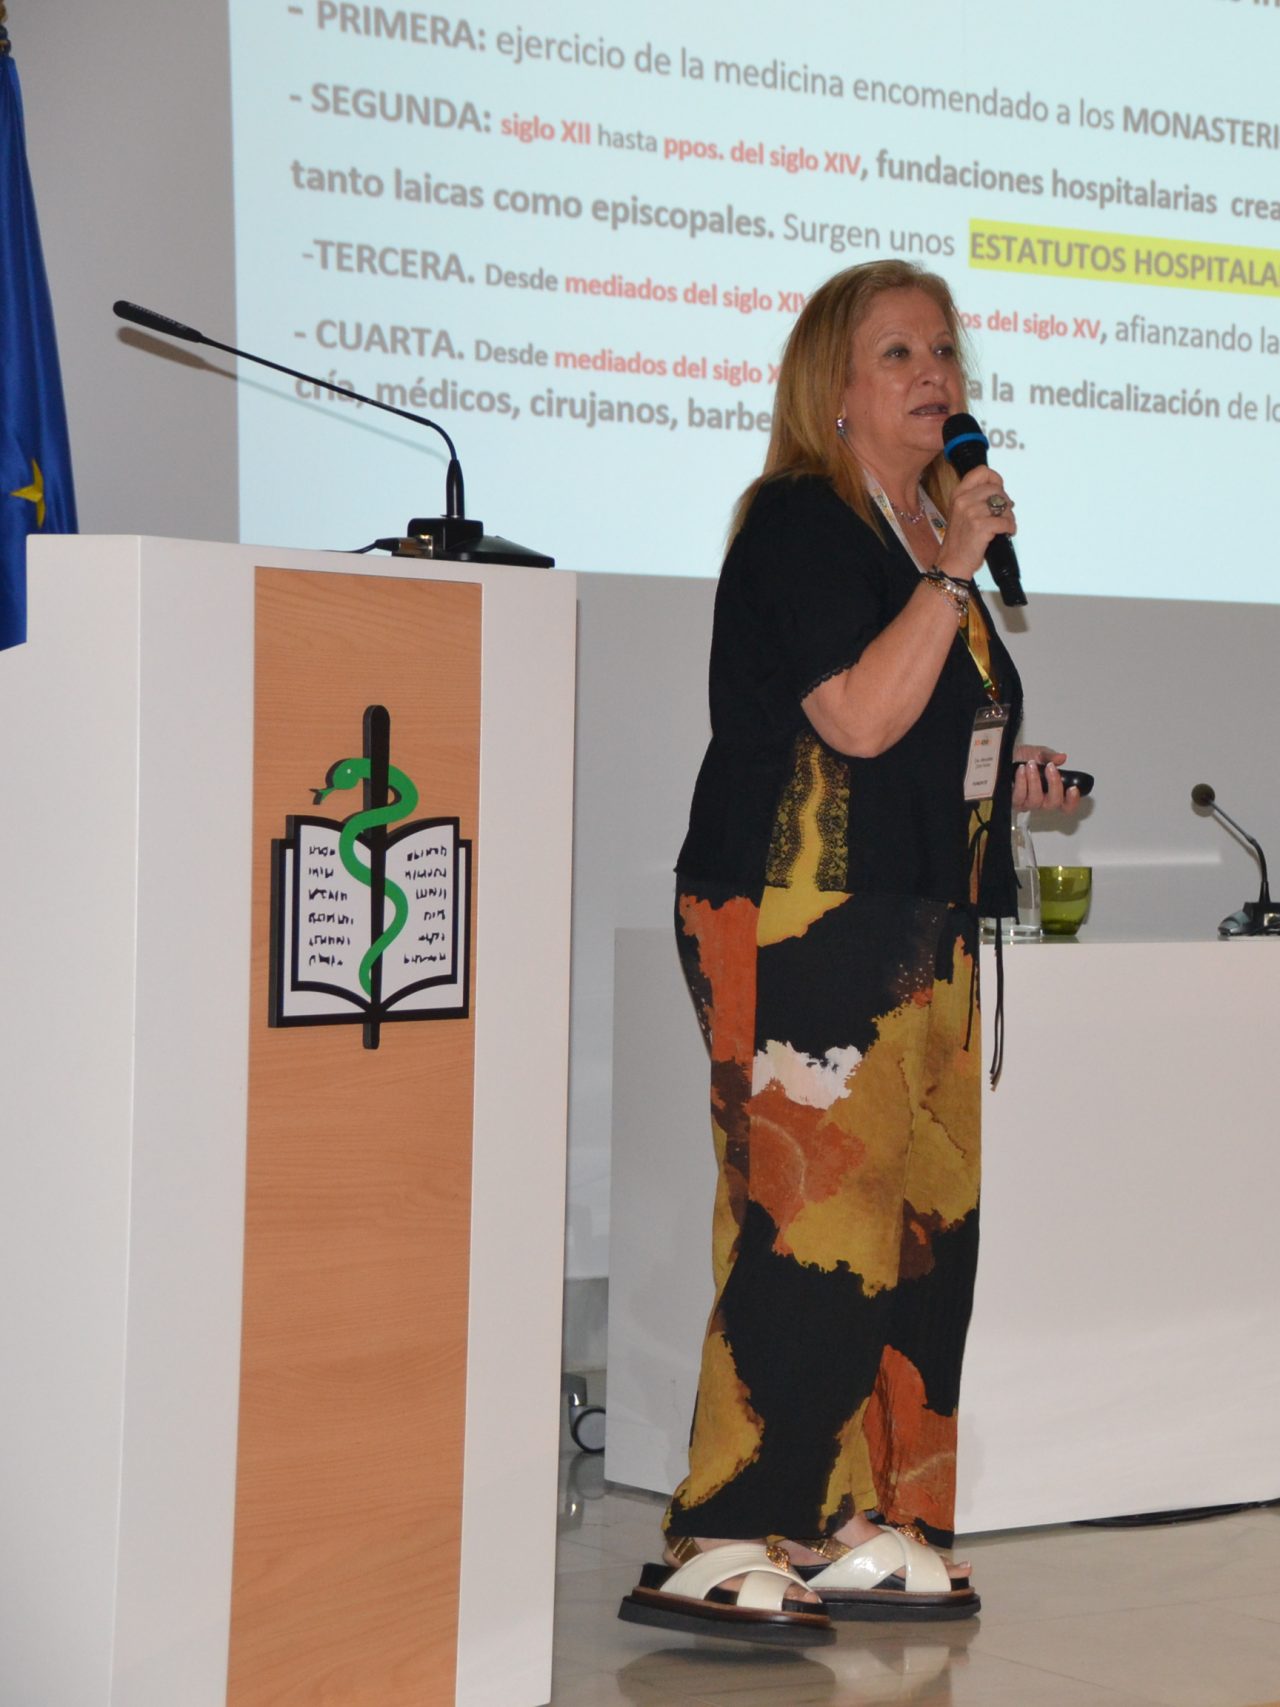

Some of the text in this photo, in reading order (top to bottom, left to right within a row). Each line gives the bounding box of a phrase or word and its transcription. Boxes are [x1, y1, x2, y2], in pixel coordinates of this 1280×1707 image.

[317, 0, 486, 52] PRIMERA:
[496, 25, 627, 70] ejercicio
[633, 41, 672, 76] de
[681, 46, 705, 81] la
[714, 59, 844, 98] medicina
[852, 78, 1050, 123] encomendado
[1055, 103, 1071, 126] a
[1079, 97, 1115, 131] los
[311, 83, 492, 134] SEGUNDA:
[501, 113, 556, 144] siglo
[560, 120, 591, 145] XII
[597, 122, 658, 153] hasta
[663, 136, 724, 161] ppos.
[730, 140, 765, 165] del
[769, 145, 820, 175] siglo
[824, 151, 869, 182] XIV,
[875, 147, 1045, 196] fundaciones
[1051, 167, 1219, 215] hospitalarias
[290, 159, 385, 198] tanto
[394, 167, 485, 209] laicas
[493, 188, 584, 219] como
[591, 194, 775, 239] episcopales.
[783, 212, 881, 254] Surgen
[889, 229, 955, 257] unos
[969, 231, 1127, 274] ESTATUTOS
[302, 238, 476, 285] -TERCERA.
[485, 263, 559, 292] Desde
[564, 274, 678, 303] mediados
[683, 282, 718, 307] del
[722, 286, 773, 315] siglo
[315, 318, 466, 361] CUARTA.
[474, 338, 549, 367] Desde
[554, 348, 668, 377] mediados
[672, 355, 707, 380] del
[712, 359, 763, 387] siglo
[986, 309, 1019, 334] del
[1022, 312, 1069, 341] siglo
[1072, 316, 1108, 346] XV,
[1114, 313, 1253, 353] afianzando
[1260, 325, 1280, 355] la
[376, 376, 521, 421] médicos,
[529, 387, 679, 431] cirujanos,
[991, 372, 1015, 403] la
[1029, 379, 1221, 419] medicalización
[1227, 391, 1259, 421] de
